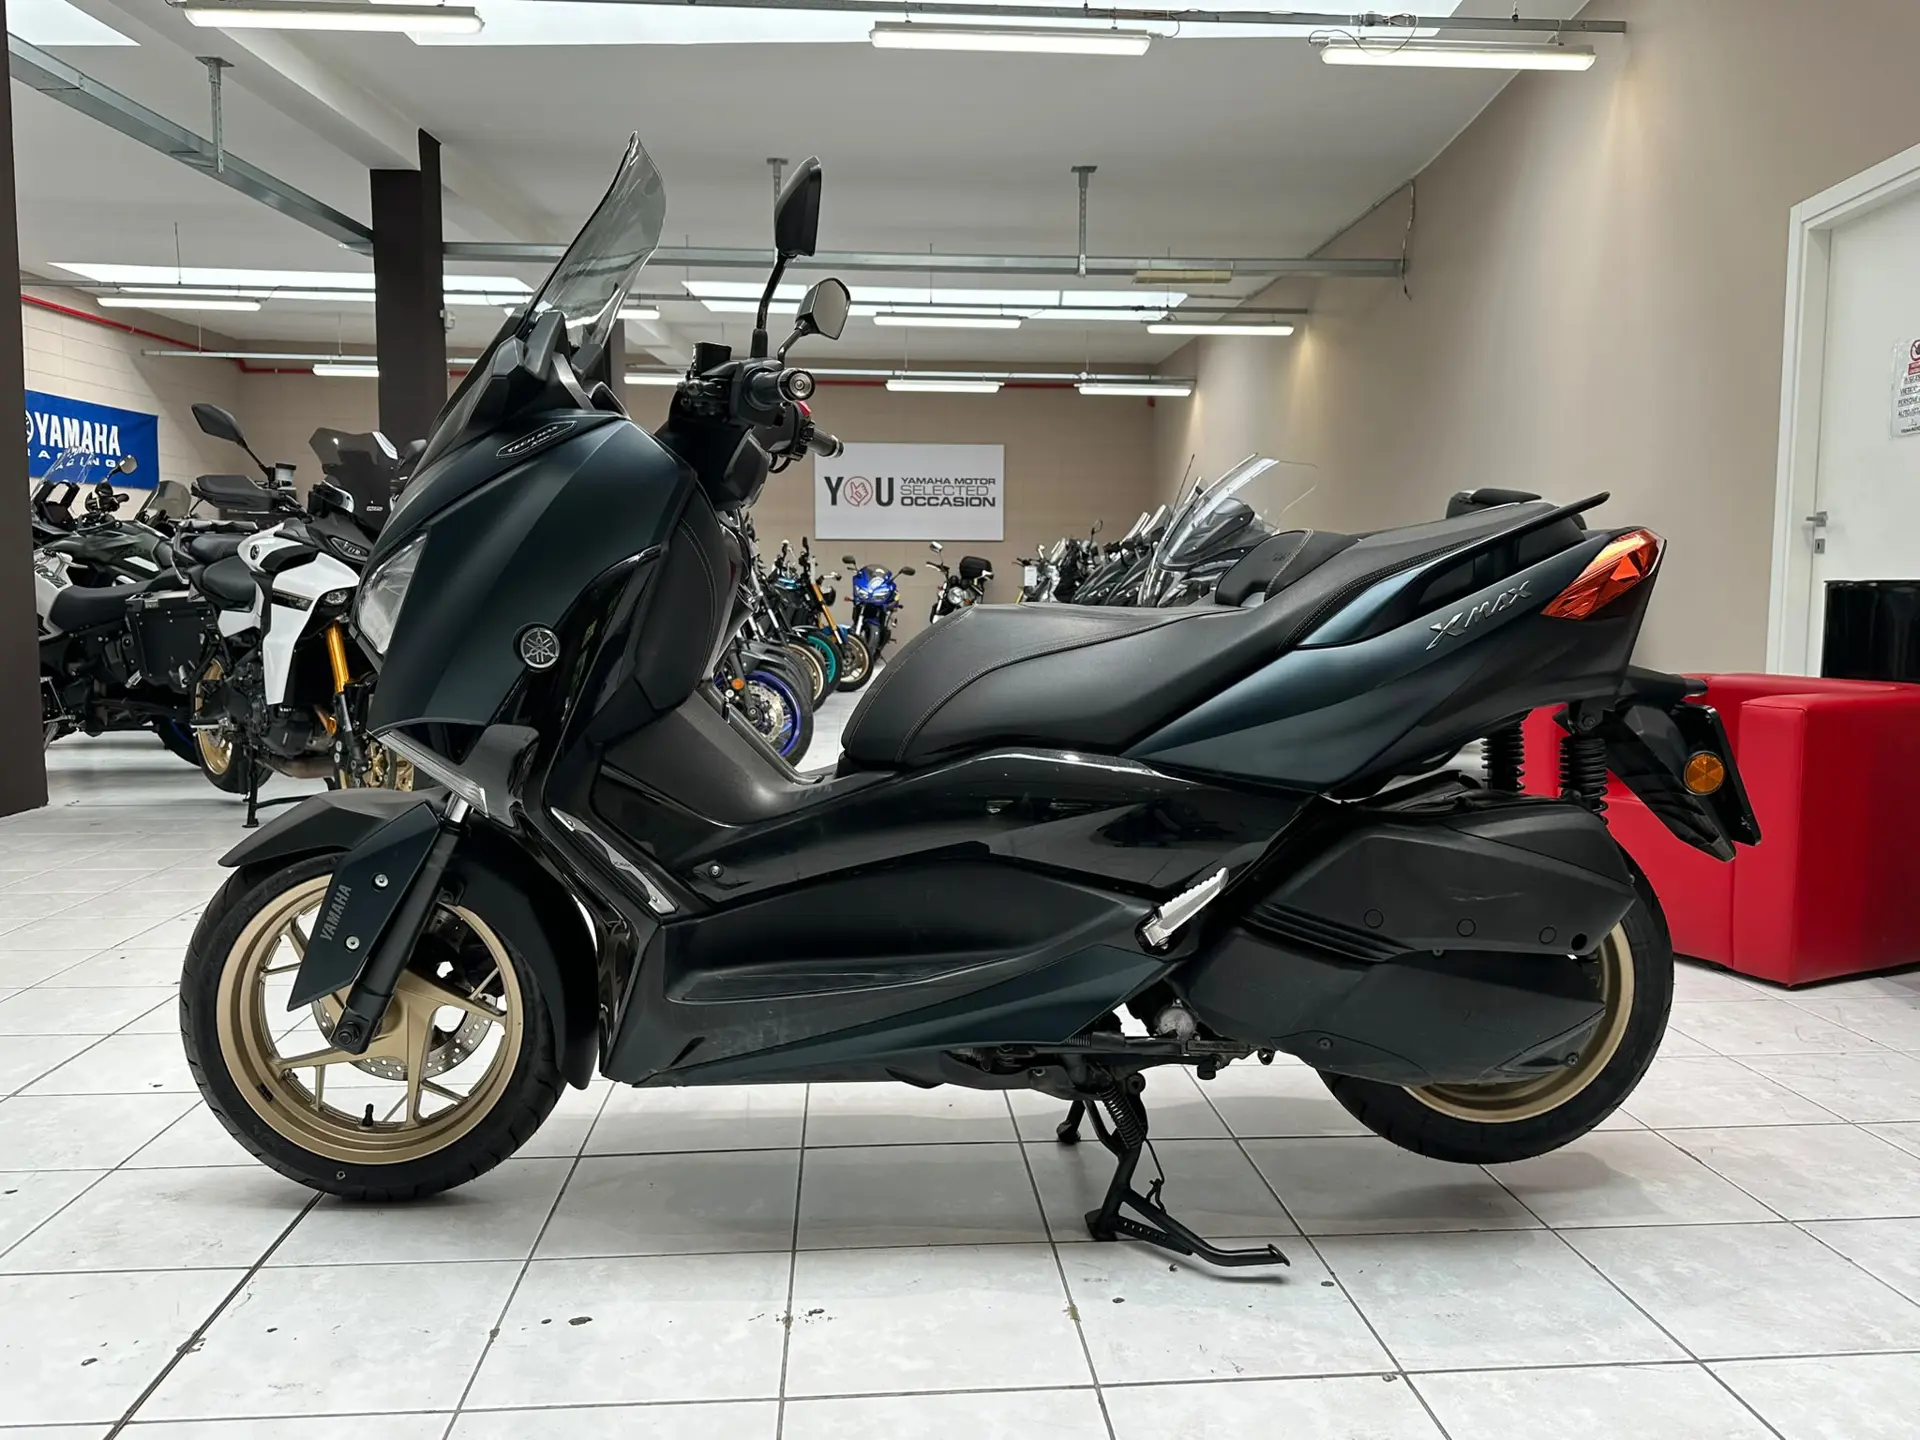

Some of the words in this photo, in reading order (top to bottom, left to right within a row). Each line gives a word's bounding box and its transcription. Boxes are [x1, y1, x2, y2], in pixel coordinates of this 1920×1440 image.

[34, 411, 121, 457] YAMAHA
[27, 448, 117, 468] ACING
[901, 477, 951, 485] YAMAHA
[954, 477, 996, 486] MOTOR
[900, 485, 989, 496] SELECTED
[901, 497, 996, 507] OCCASION
[320, 884, 352, 941] YAMAHA
